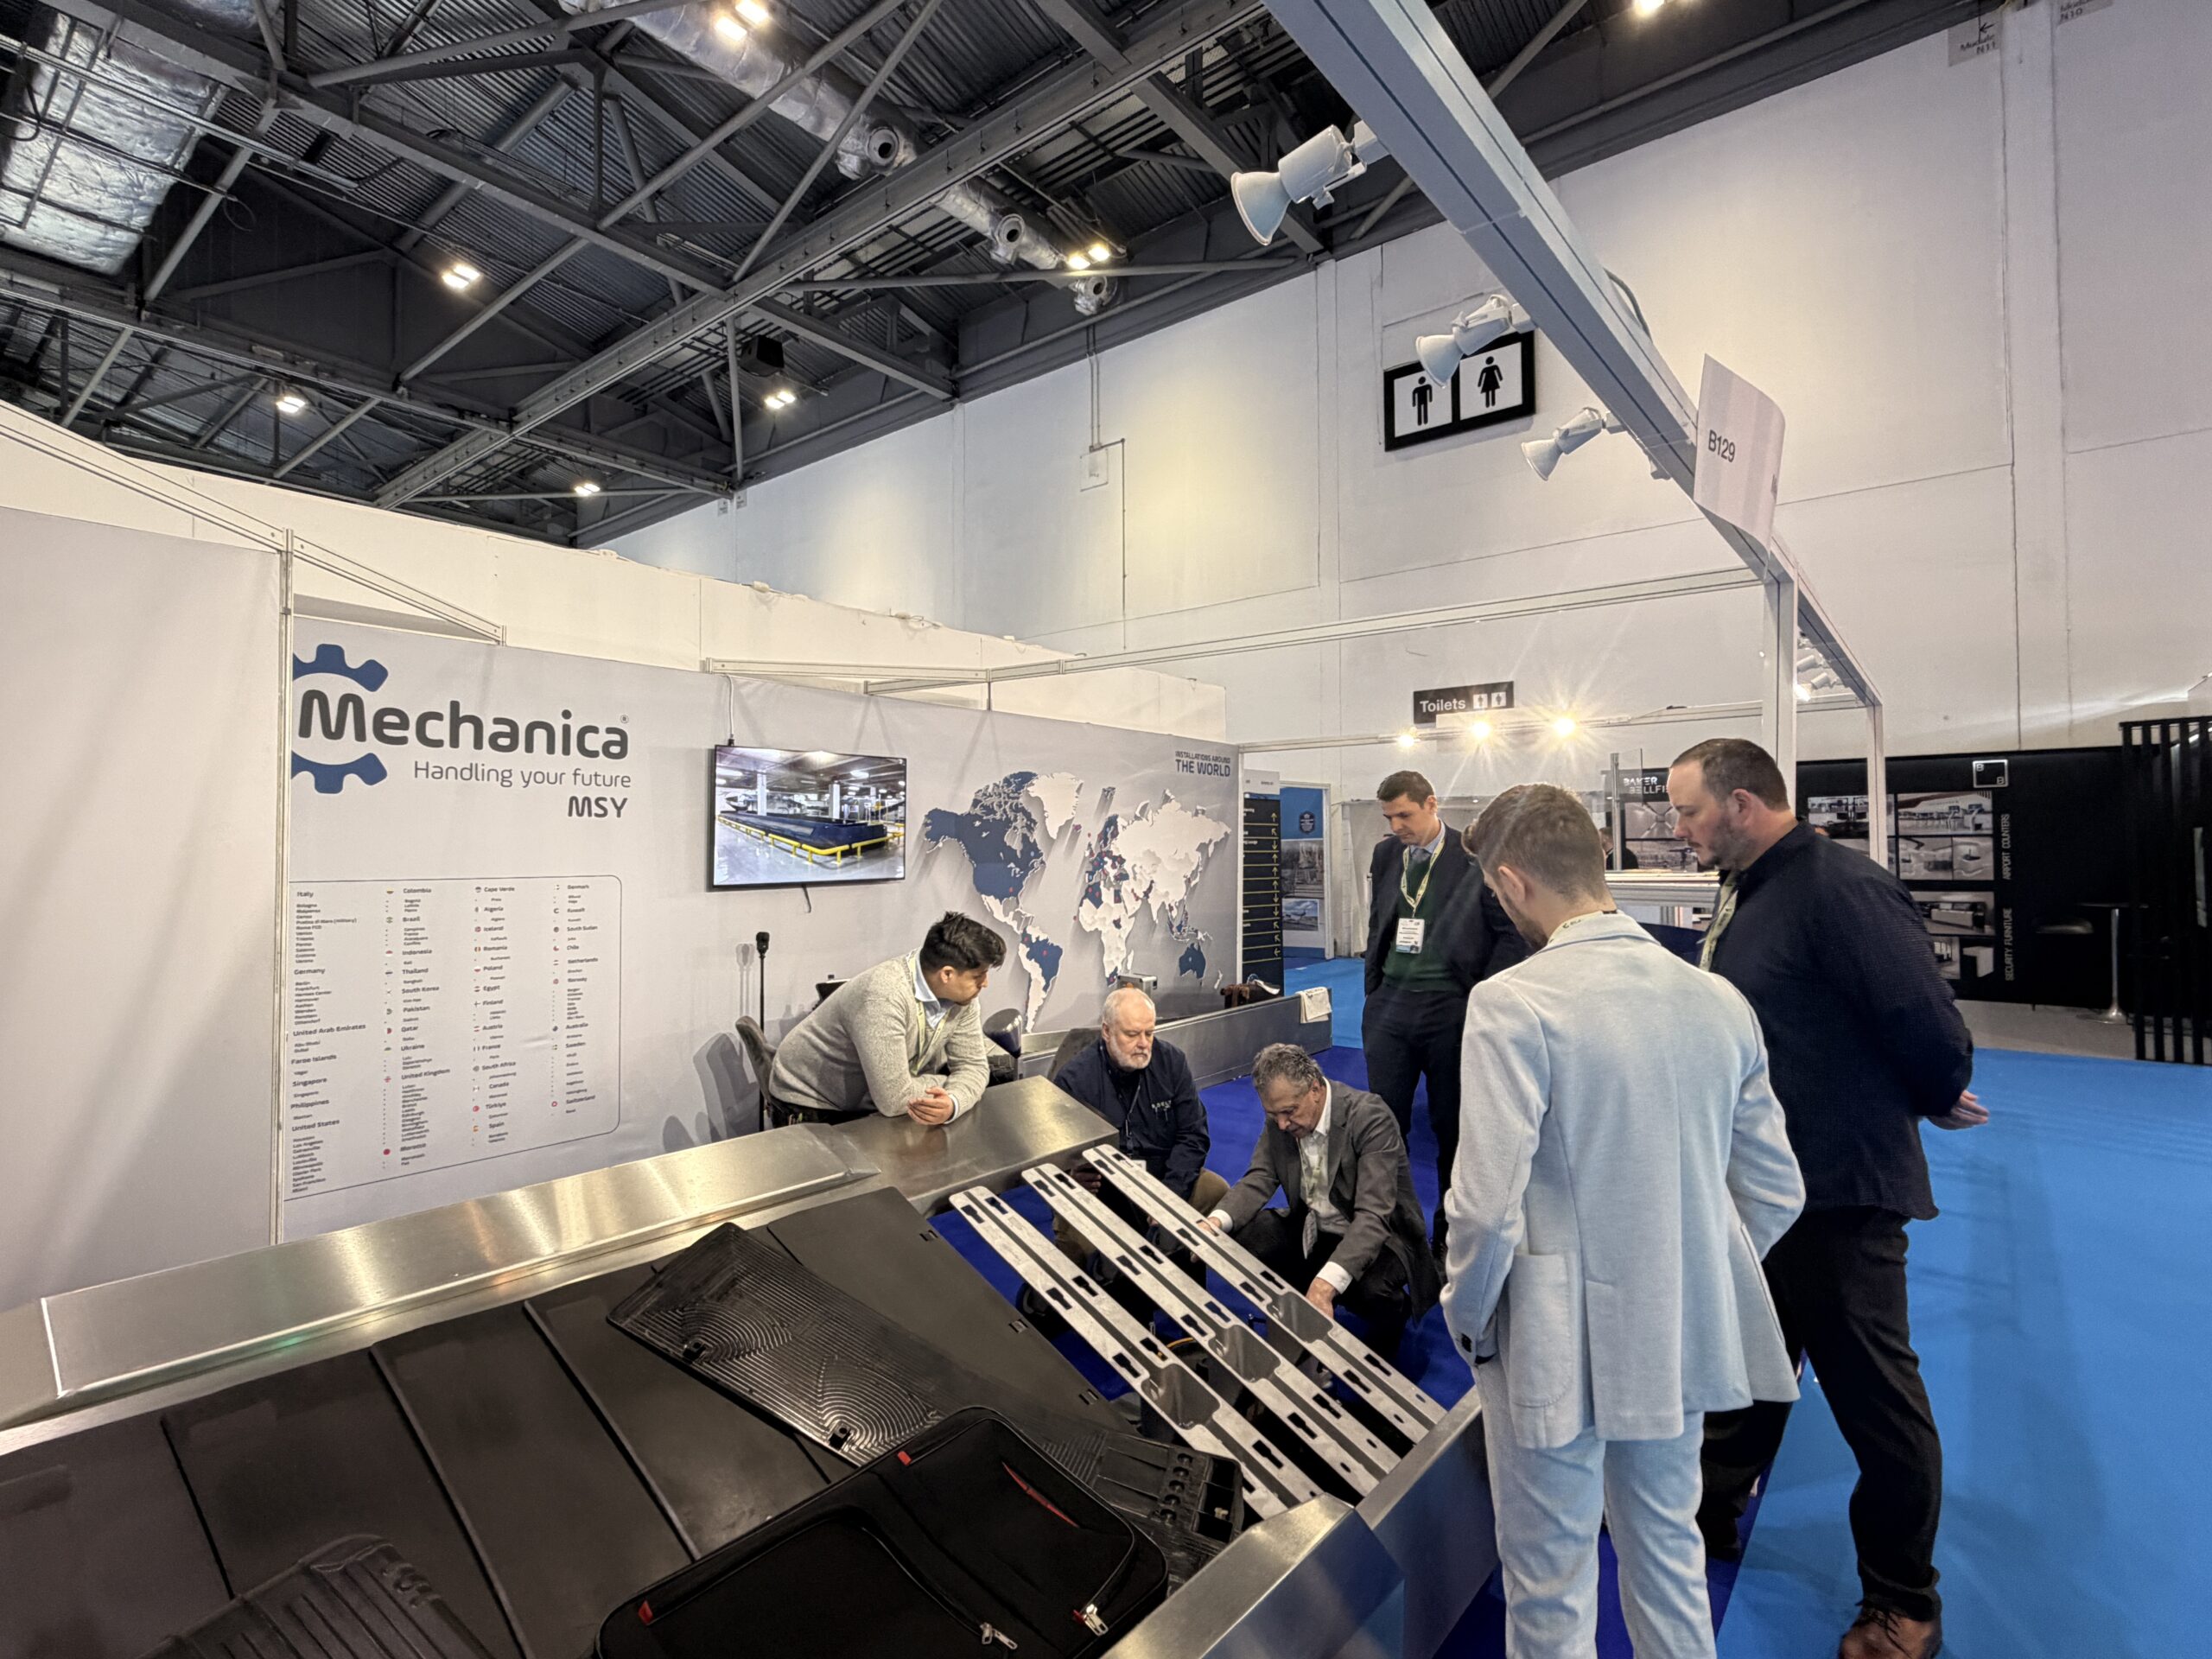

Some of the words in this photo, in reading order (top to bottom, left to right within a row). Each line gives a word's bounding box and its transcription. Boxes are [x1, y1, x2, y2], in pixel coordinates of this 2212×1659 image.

[1708, 429, 1736, 463] B129
[1420, 698, 1466, 713] Toilets
[299, 690, 629, 760] Mechanica
[414, 760, 513, 787] Handling
[520, 769, 565, 788] your
[572, 768, 632, 788] future
[1175, 759, 1195, 774] THE
[1197, 761, 1230, 778] WORLD
[1630, 785, 1669, 795] BELLFI
[567, 795, 628, 818] MSY
[2000, 814, 2012, 849] COUNTERS
[293, 1078, 327, 1087] Singapore
[290, 1099, 330, 1109] Philippines
